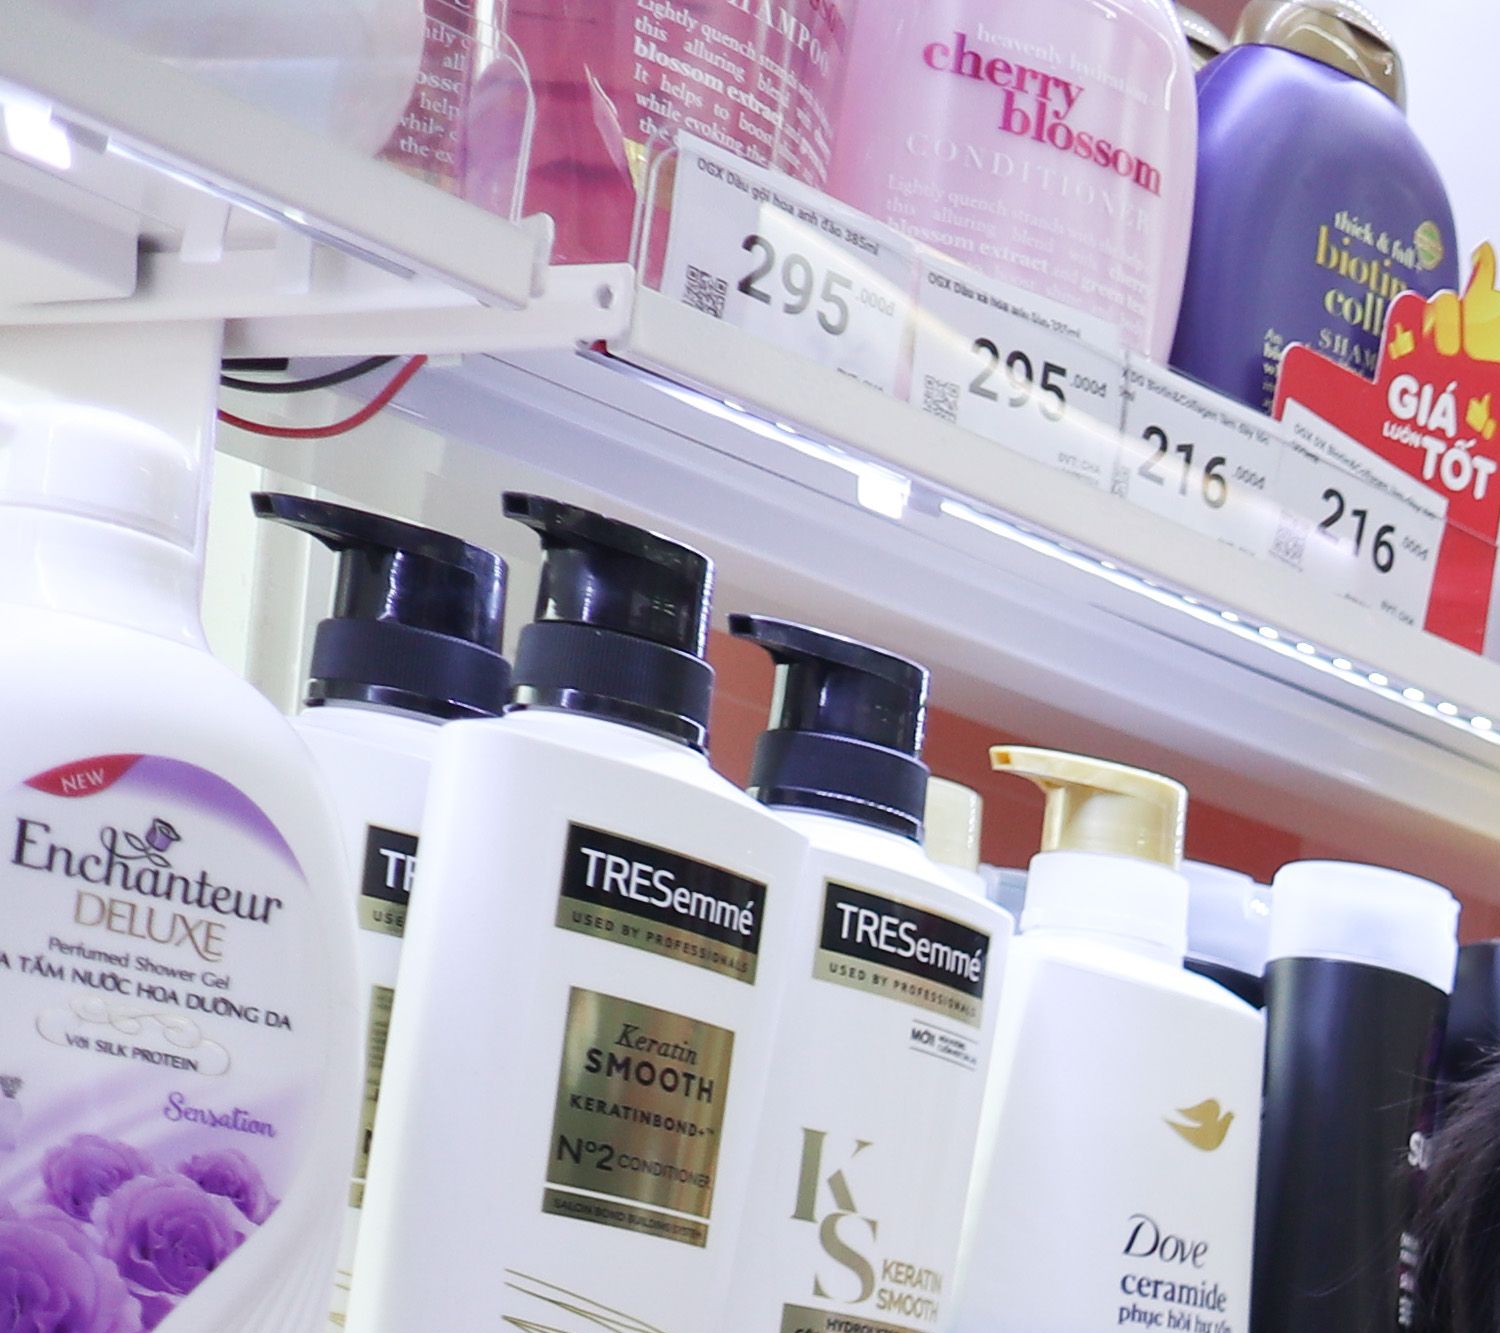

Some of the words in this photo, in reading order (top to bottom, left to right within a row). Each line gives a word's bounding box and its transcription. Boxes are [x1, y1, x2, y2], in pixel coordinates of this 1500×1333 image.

[634, 17, 669, 43] this
[683, 37, 747, 83] alluring
[921, 31, 1085, 121] cherry
[633, 38, 725, 92] blossom
[727, 80, 785, 129] extract
[634, 64, 650, 83] It
[660, 73, 703, 111] helps
[714, 101, 730, 121] to
[636, 91, 683, 122] while
[683, 107, 745, 155] evoking
[639, 116, 669, 141] the
[997, 87, 1163, 198] blossom
[697, 155, 724, 181] OGX
[1333, 209, 1374, 246] thick
[737, 233, 853, 338] 295
[1315, 223, 1408, 303] biotin
[968, 335, 1069, 424] 295
[1387, 373, 1458, 437] GIÁ
[1136, 423, 1229, 510] 216
[1421, 436, 1498, 501] TỐT
[1314, 486, 1396, 574] 216
[60, 768, 106, 793] NEW
[10, 816, 284, 925] Enchanteur
[580, 846, 756, 937] TRESemmé
[72, 888, 228, 963] DELUXE
[571, 909, 615, 933] USED
[621, 922, 641, 939] BY
[645, 928, 751, 976] PROFESSIONALS
[836, 900, 984, 983] TRESemmé
[18, 950, 65, 982] TẮM
[71, 967, 133, 998] NƯỚC
[135, 980, 180, 1007] HOA
[263, 1008, 293, 1032] DA
[47, 935, 130, 969] Perfumed
[134, 955, 197, 985] Shower
[200, 970, 232, 992] Gel
[828, 961, 867, 984] USED
[871, 967, 889, 988] BY
[892, 978, 978, 1019] PROFESSIONALS
[94, 1038, 128, 1059] SILK
[130, 1045, 201, 1074] PROTEIN
[583, 1047, 716, 1105] SMOOTH
[613, 1021, 700, 1068] Keratin
[162, 1089, 278, 1139] Sensation
[616, 1154, 712, 1190] CONDITIONER
[1122, 1212, 1209, 1269] Dove
[875, 1287, 939, 1323] SMOOTH
[880, 1258, 944, 1297] KERATIN
[1119, 1272, 1229, 1313] ceramide
[1117, 1301, 1164, 1331] phục
[1166, 1308, 1193, 1333] hồi
